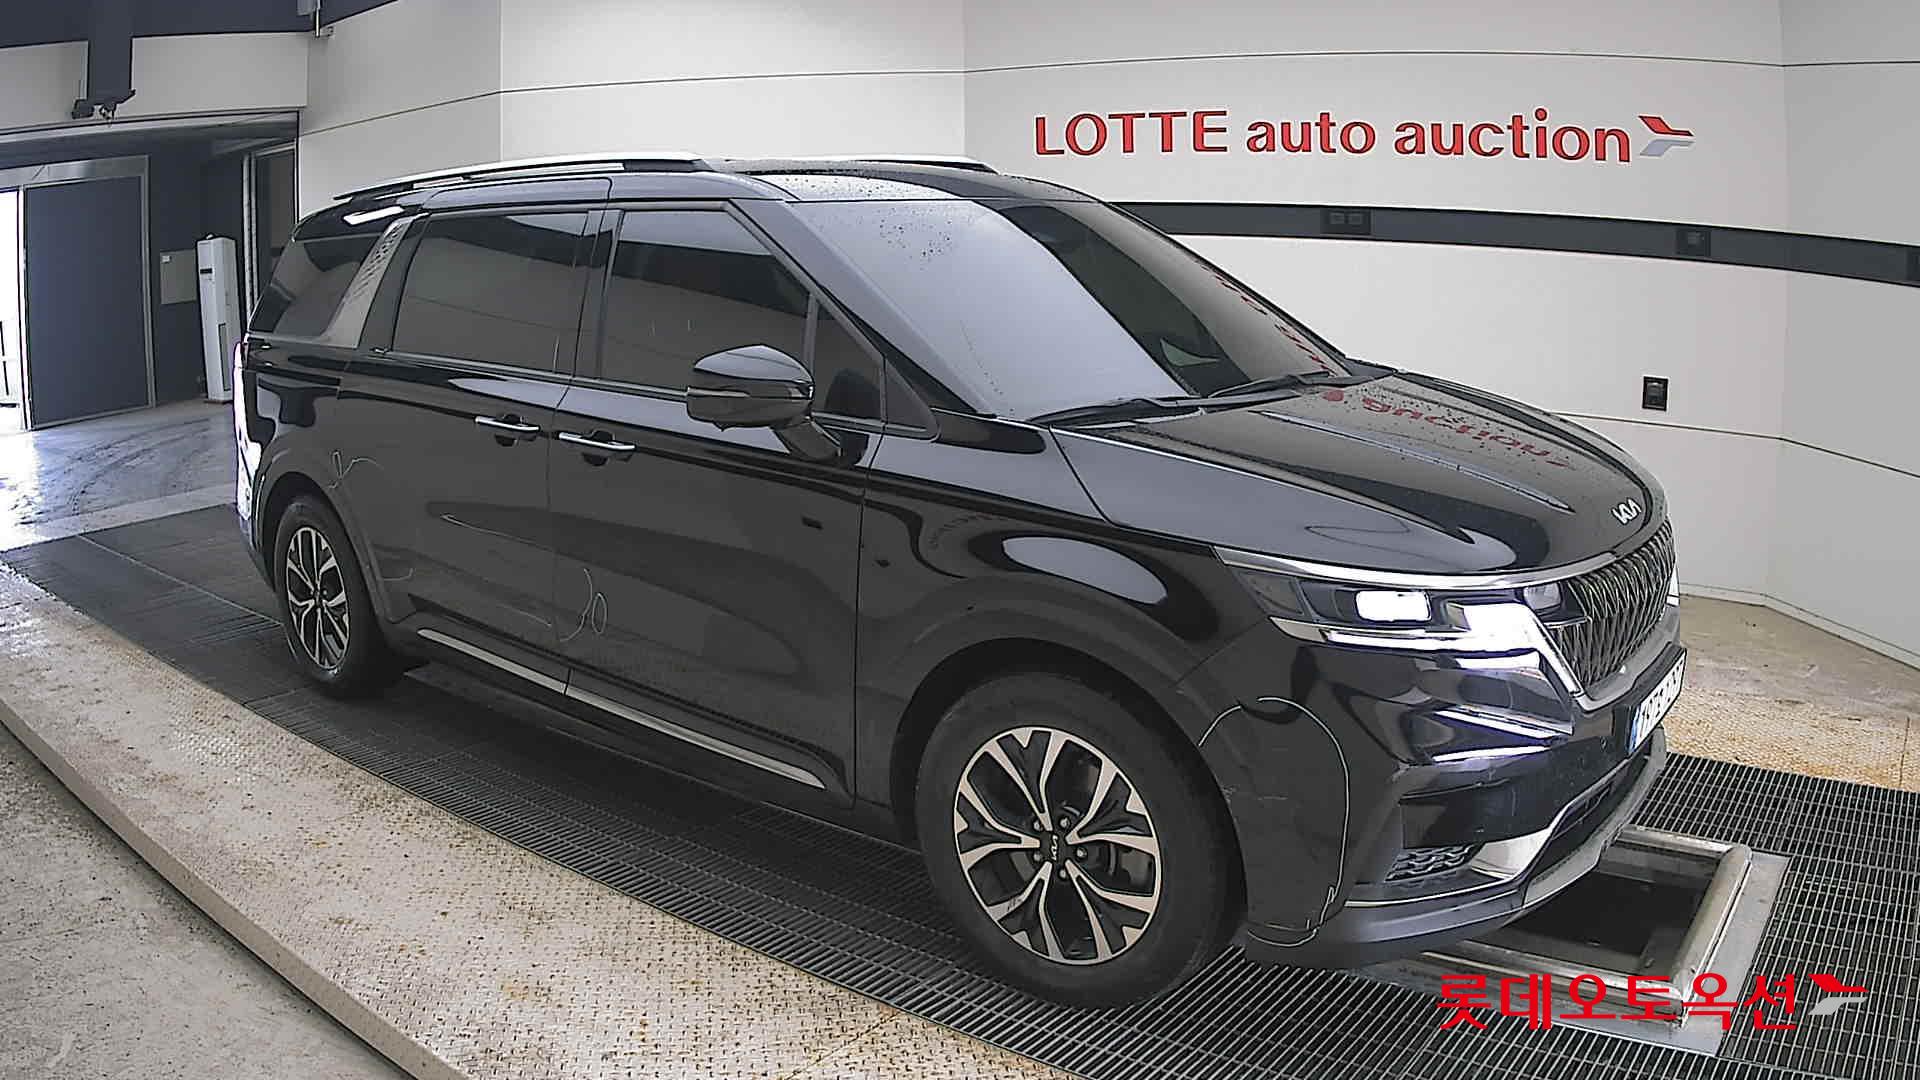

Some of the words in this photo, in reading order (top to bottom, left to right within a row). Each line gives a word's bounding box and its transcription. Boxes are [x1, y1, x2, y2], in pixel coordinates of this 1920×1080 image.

[1035, 110, 1228, 156] LOTTE
[1246, 112, 1376, 154] auto
[1394, 108, 1631, 162] auction
